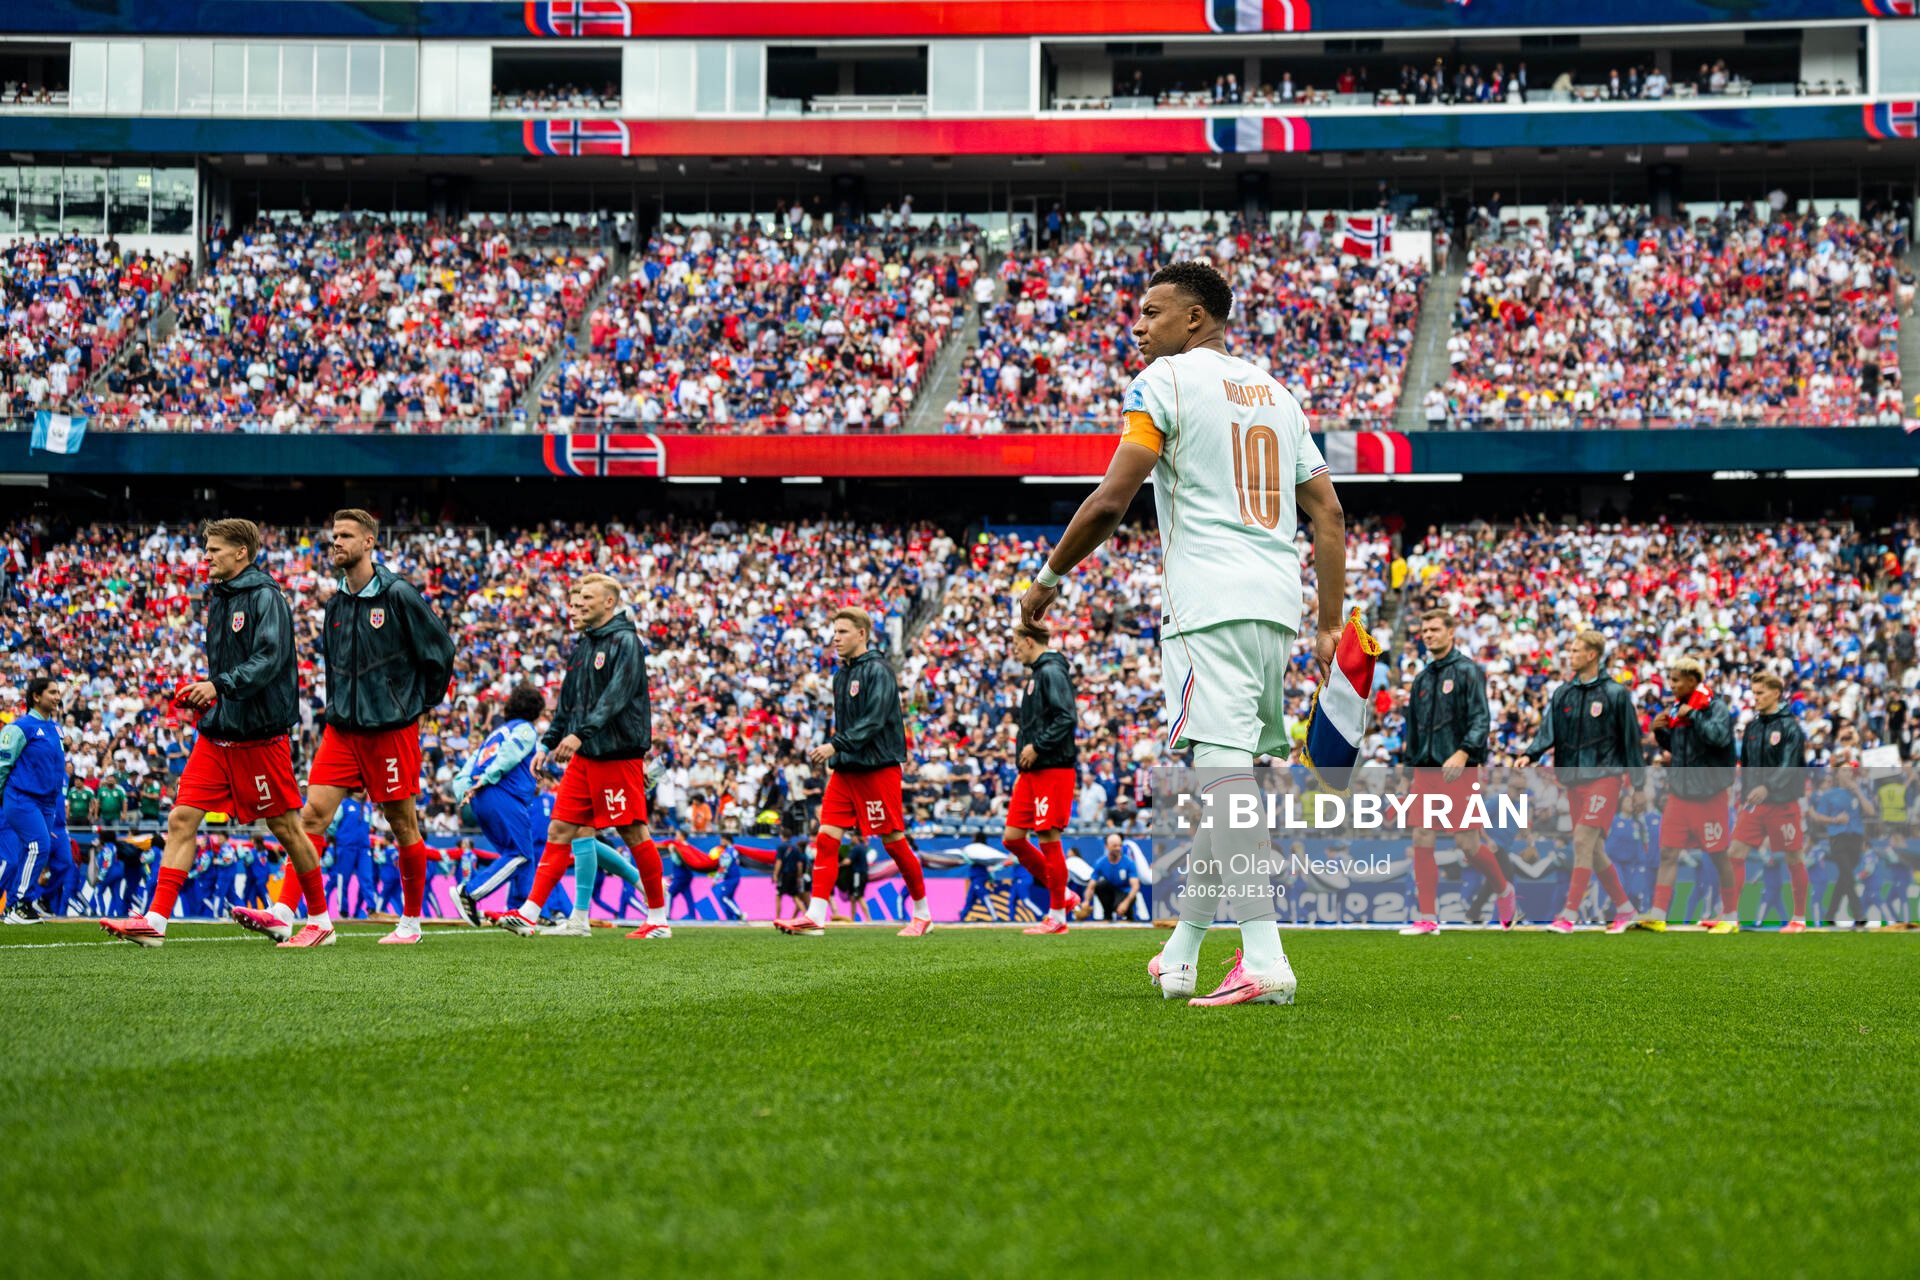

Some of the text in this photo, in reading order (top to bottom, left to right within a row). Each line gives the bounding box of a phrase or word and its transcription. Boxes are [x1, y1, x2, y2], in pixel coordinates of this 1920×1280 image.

[1231, 422, 1281, 530] 10
[385, 758, 399, 783] 3
[255, 775, 271, 800] 5
[604, 788, 626, 811] 24
[865, 800, 885, 821] 23
[1034, 796, 1049, 817] 16
